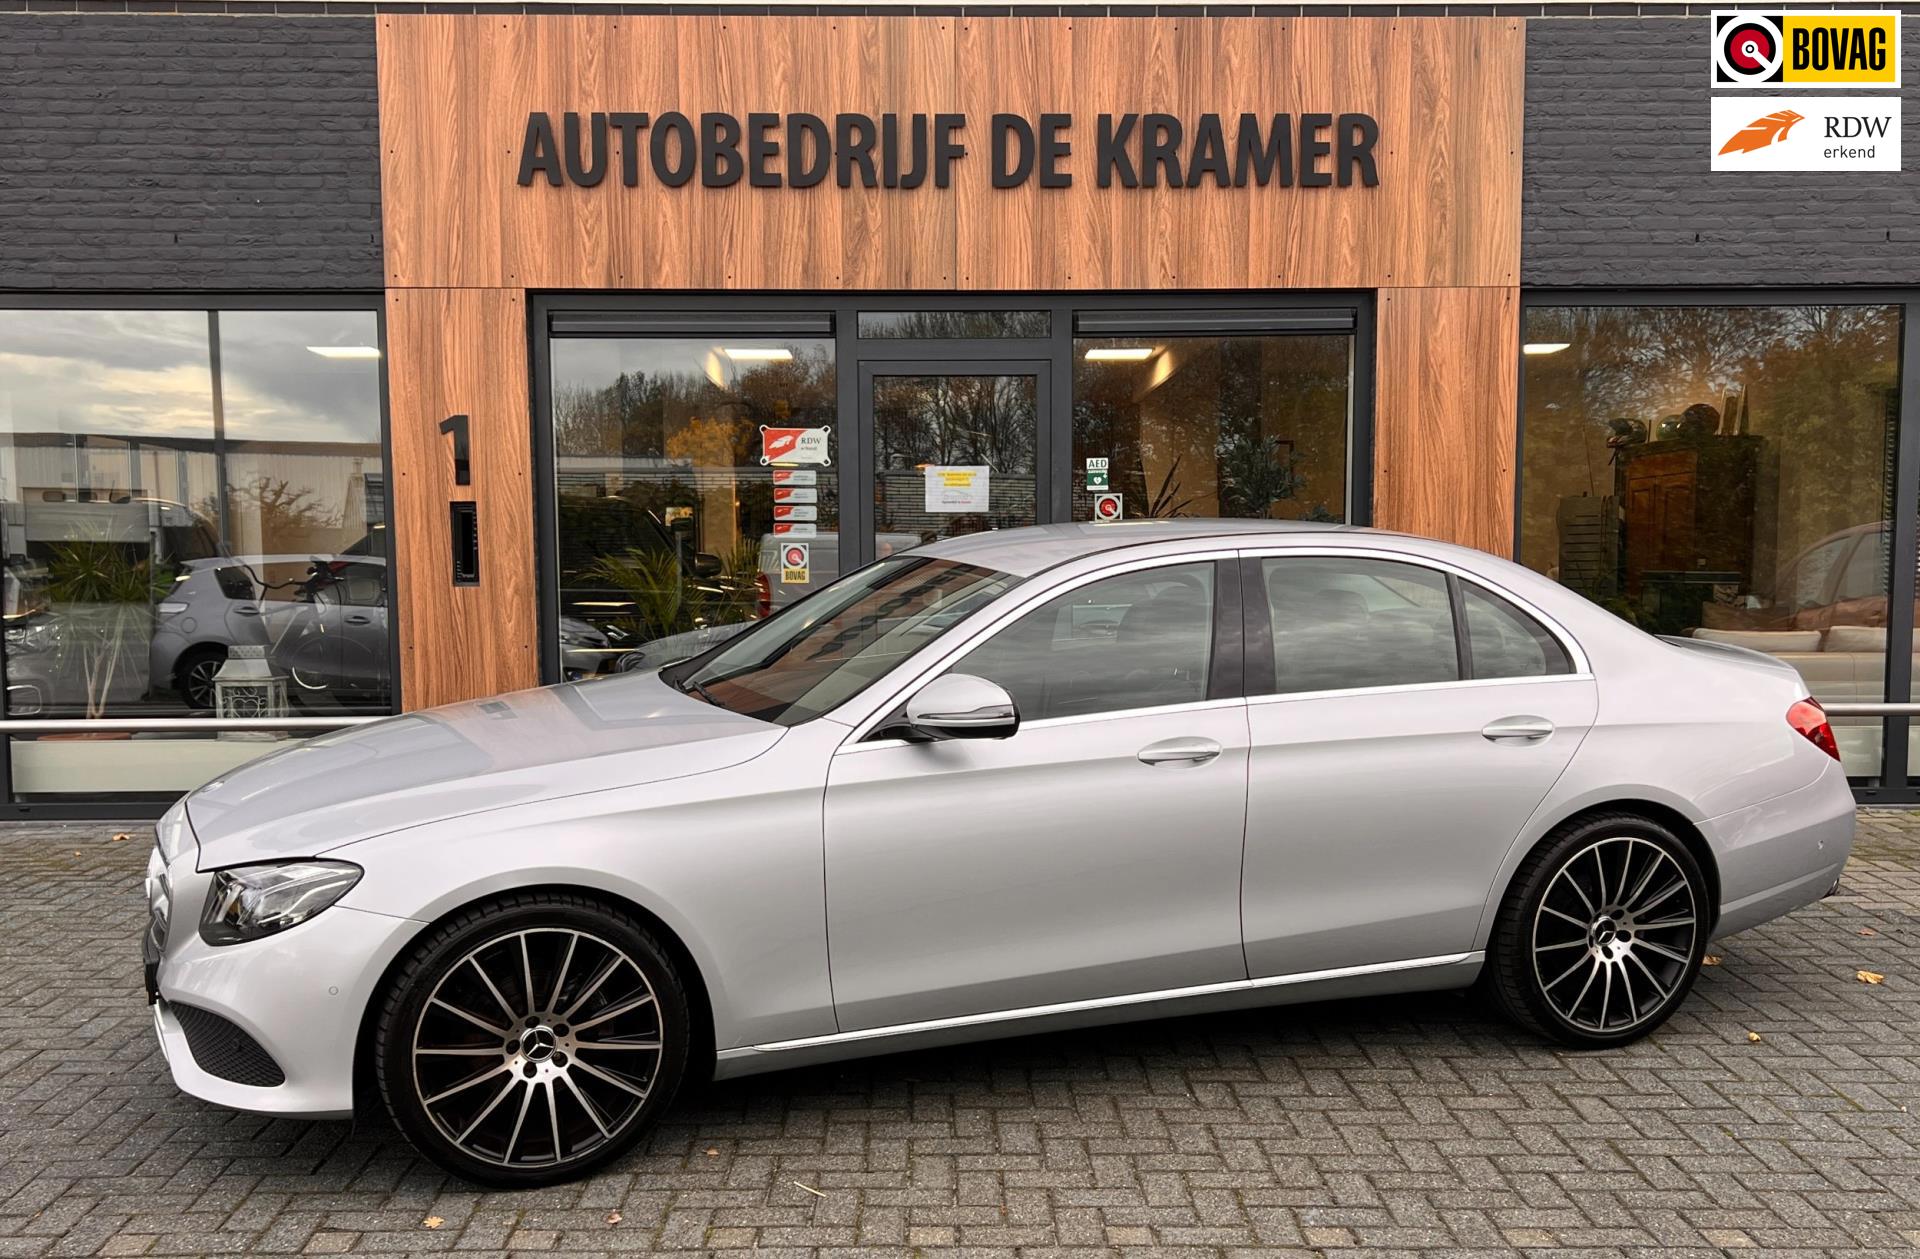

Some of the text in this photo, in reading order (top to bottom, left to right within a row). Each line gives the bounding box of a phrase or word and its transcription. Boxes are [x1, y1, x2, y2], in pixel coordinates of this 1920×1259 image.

[517, 111, 1380, 189] AUTOBEDRIJF DE KRAMER
[439, 415, 471, 486] 1
[1088, 459, 1107, 468] AED
[785, 570, 806, 581] BOVAG
